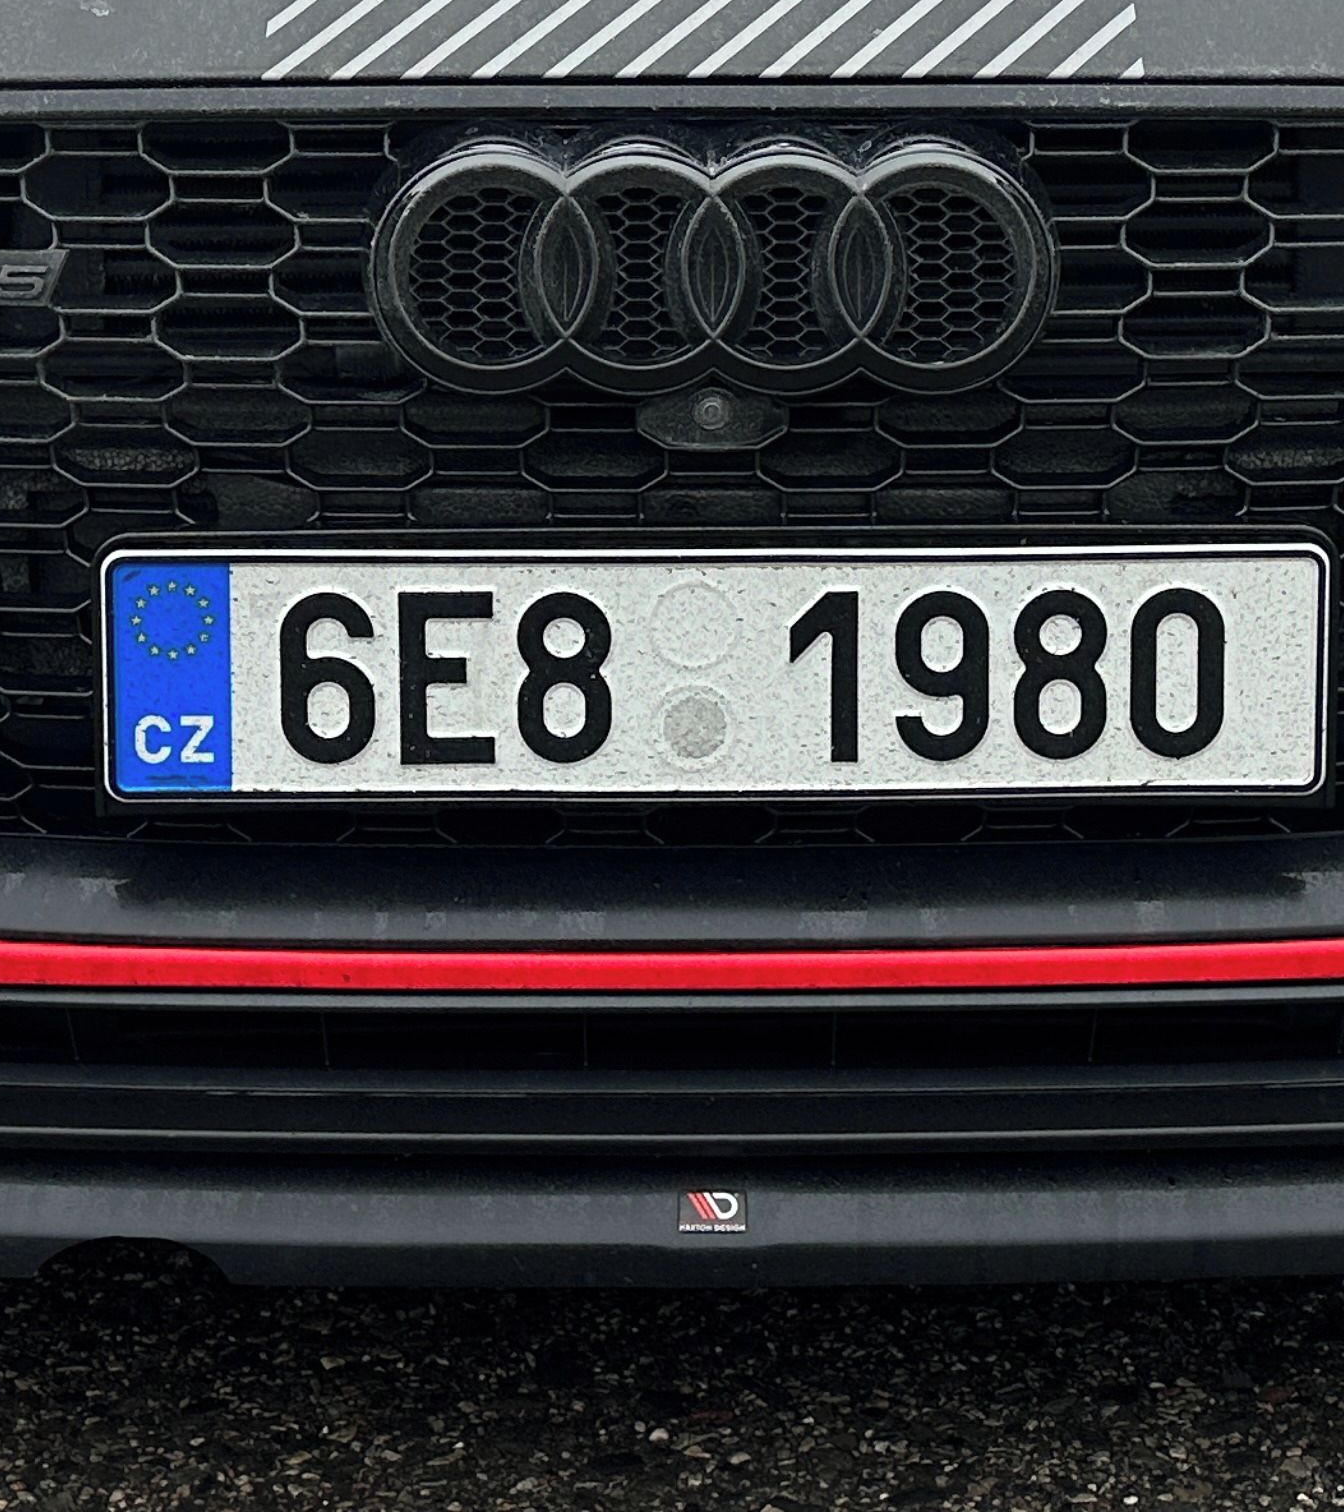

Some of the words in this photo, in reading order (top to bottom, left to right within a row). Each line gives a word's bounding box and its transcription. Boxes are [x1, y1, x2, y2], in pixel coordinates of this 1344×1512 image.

[278, 591, 613, 766] 6E8
[788, 588, 1226, 762] 1980
[134, 715, 215, 764] CZ
